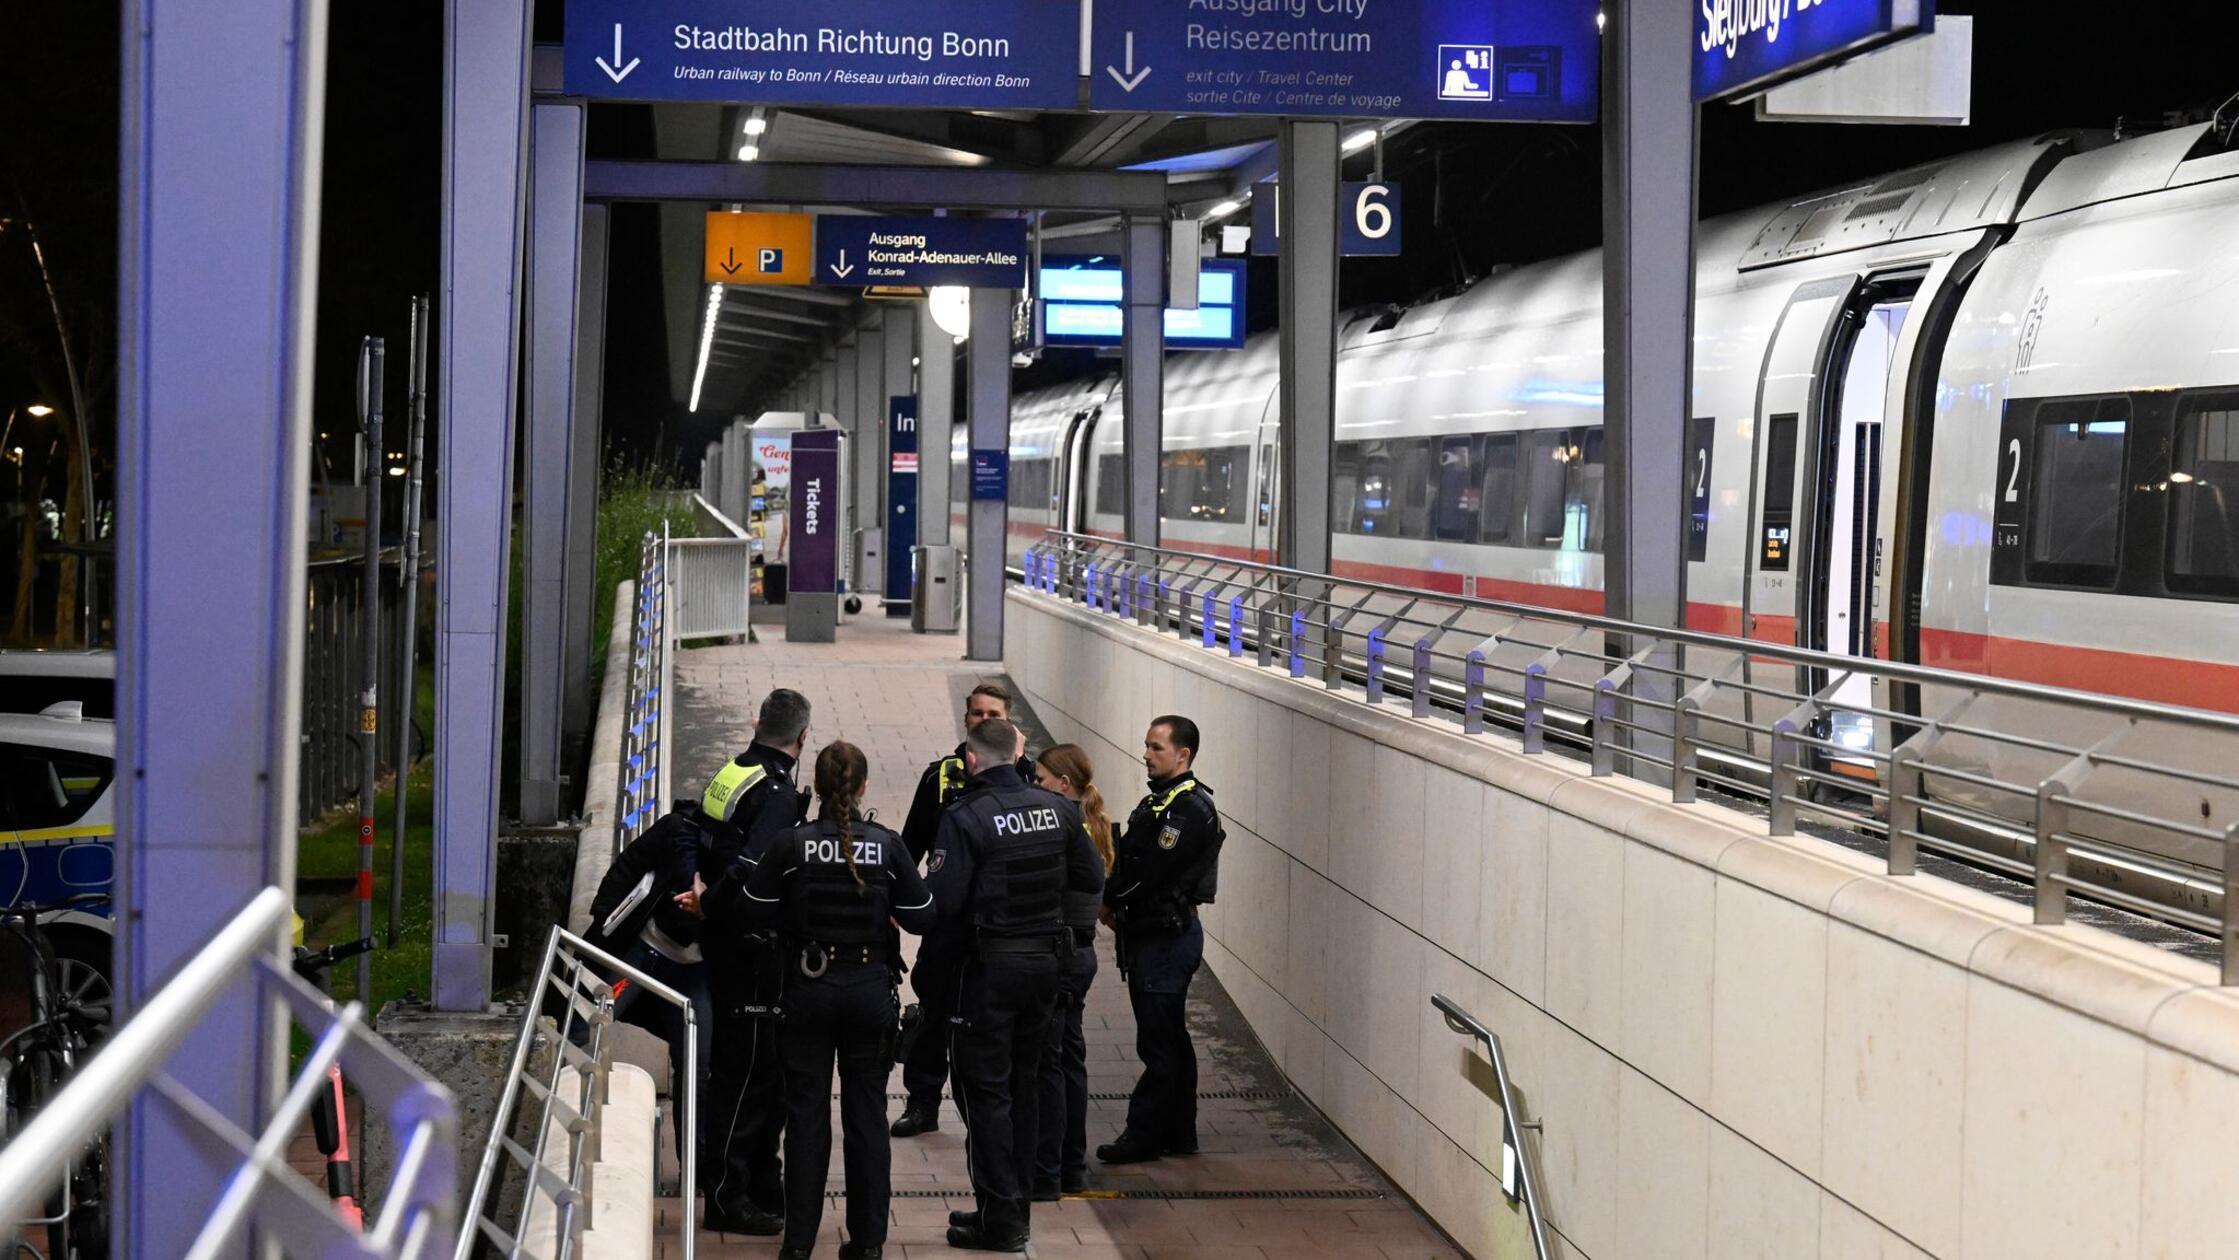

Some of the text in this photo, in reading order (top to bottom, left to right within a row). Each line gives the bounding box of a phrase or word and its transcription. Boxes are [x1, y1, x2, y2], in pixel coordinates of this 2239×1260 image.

[674, 24, 1009, 61] Stadtbahn Richtung Bonn
[1187, 23, 1371, 52] Reisezentrum
[674, 65, 1030, 88] Urban railway to Bonn / Réseau urbain direction Bonn
[1186, 69, 1213, 83] exit
[1216, 70, 1244, 86] city
[1258, 70, 1300, 85] Travel
[1305, 71, 1354, 86] Center
[1186, 89, 1228, 104] sortie
[1275, 90, 1324, 106] Centre
[1327, 92, 1346, 106] de
[1350, 95, 1402, 110] voyage
[1355, 184, 1392, 239] 6
[868, 232, 926, 247] Ausgang
[759, 249, 777, 272] P
[868, 250, 1018, 265] Konrad-Adenauer-Allee
[897, 412, 918, 432] In
[1695, 447, 1707, 498] 2
[2004, 438, 2021, 502] 2
[805, 477, 821, 535] Tickets
[993, 807, 1060, 836] POLIZEI
[804, 839, 882, 866] POLZEI
